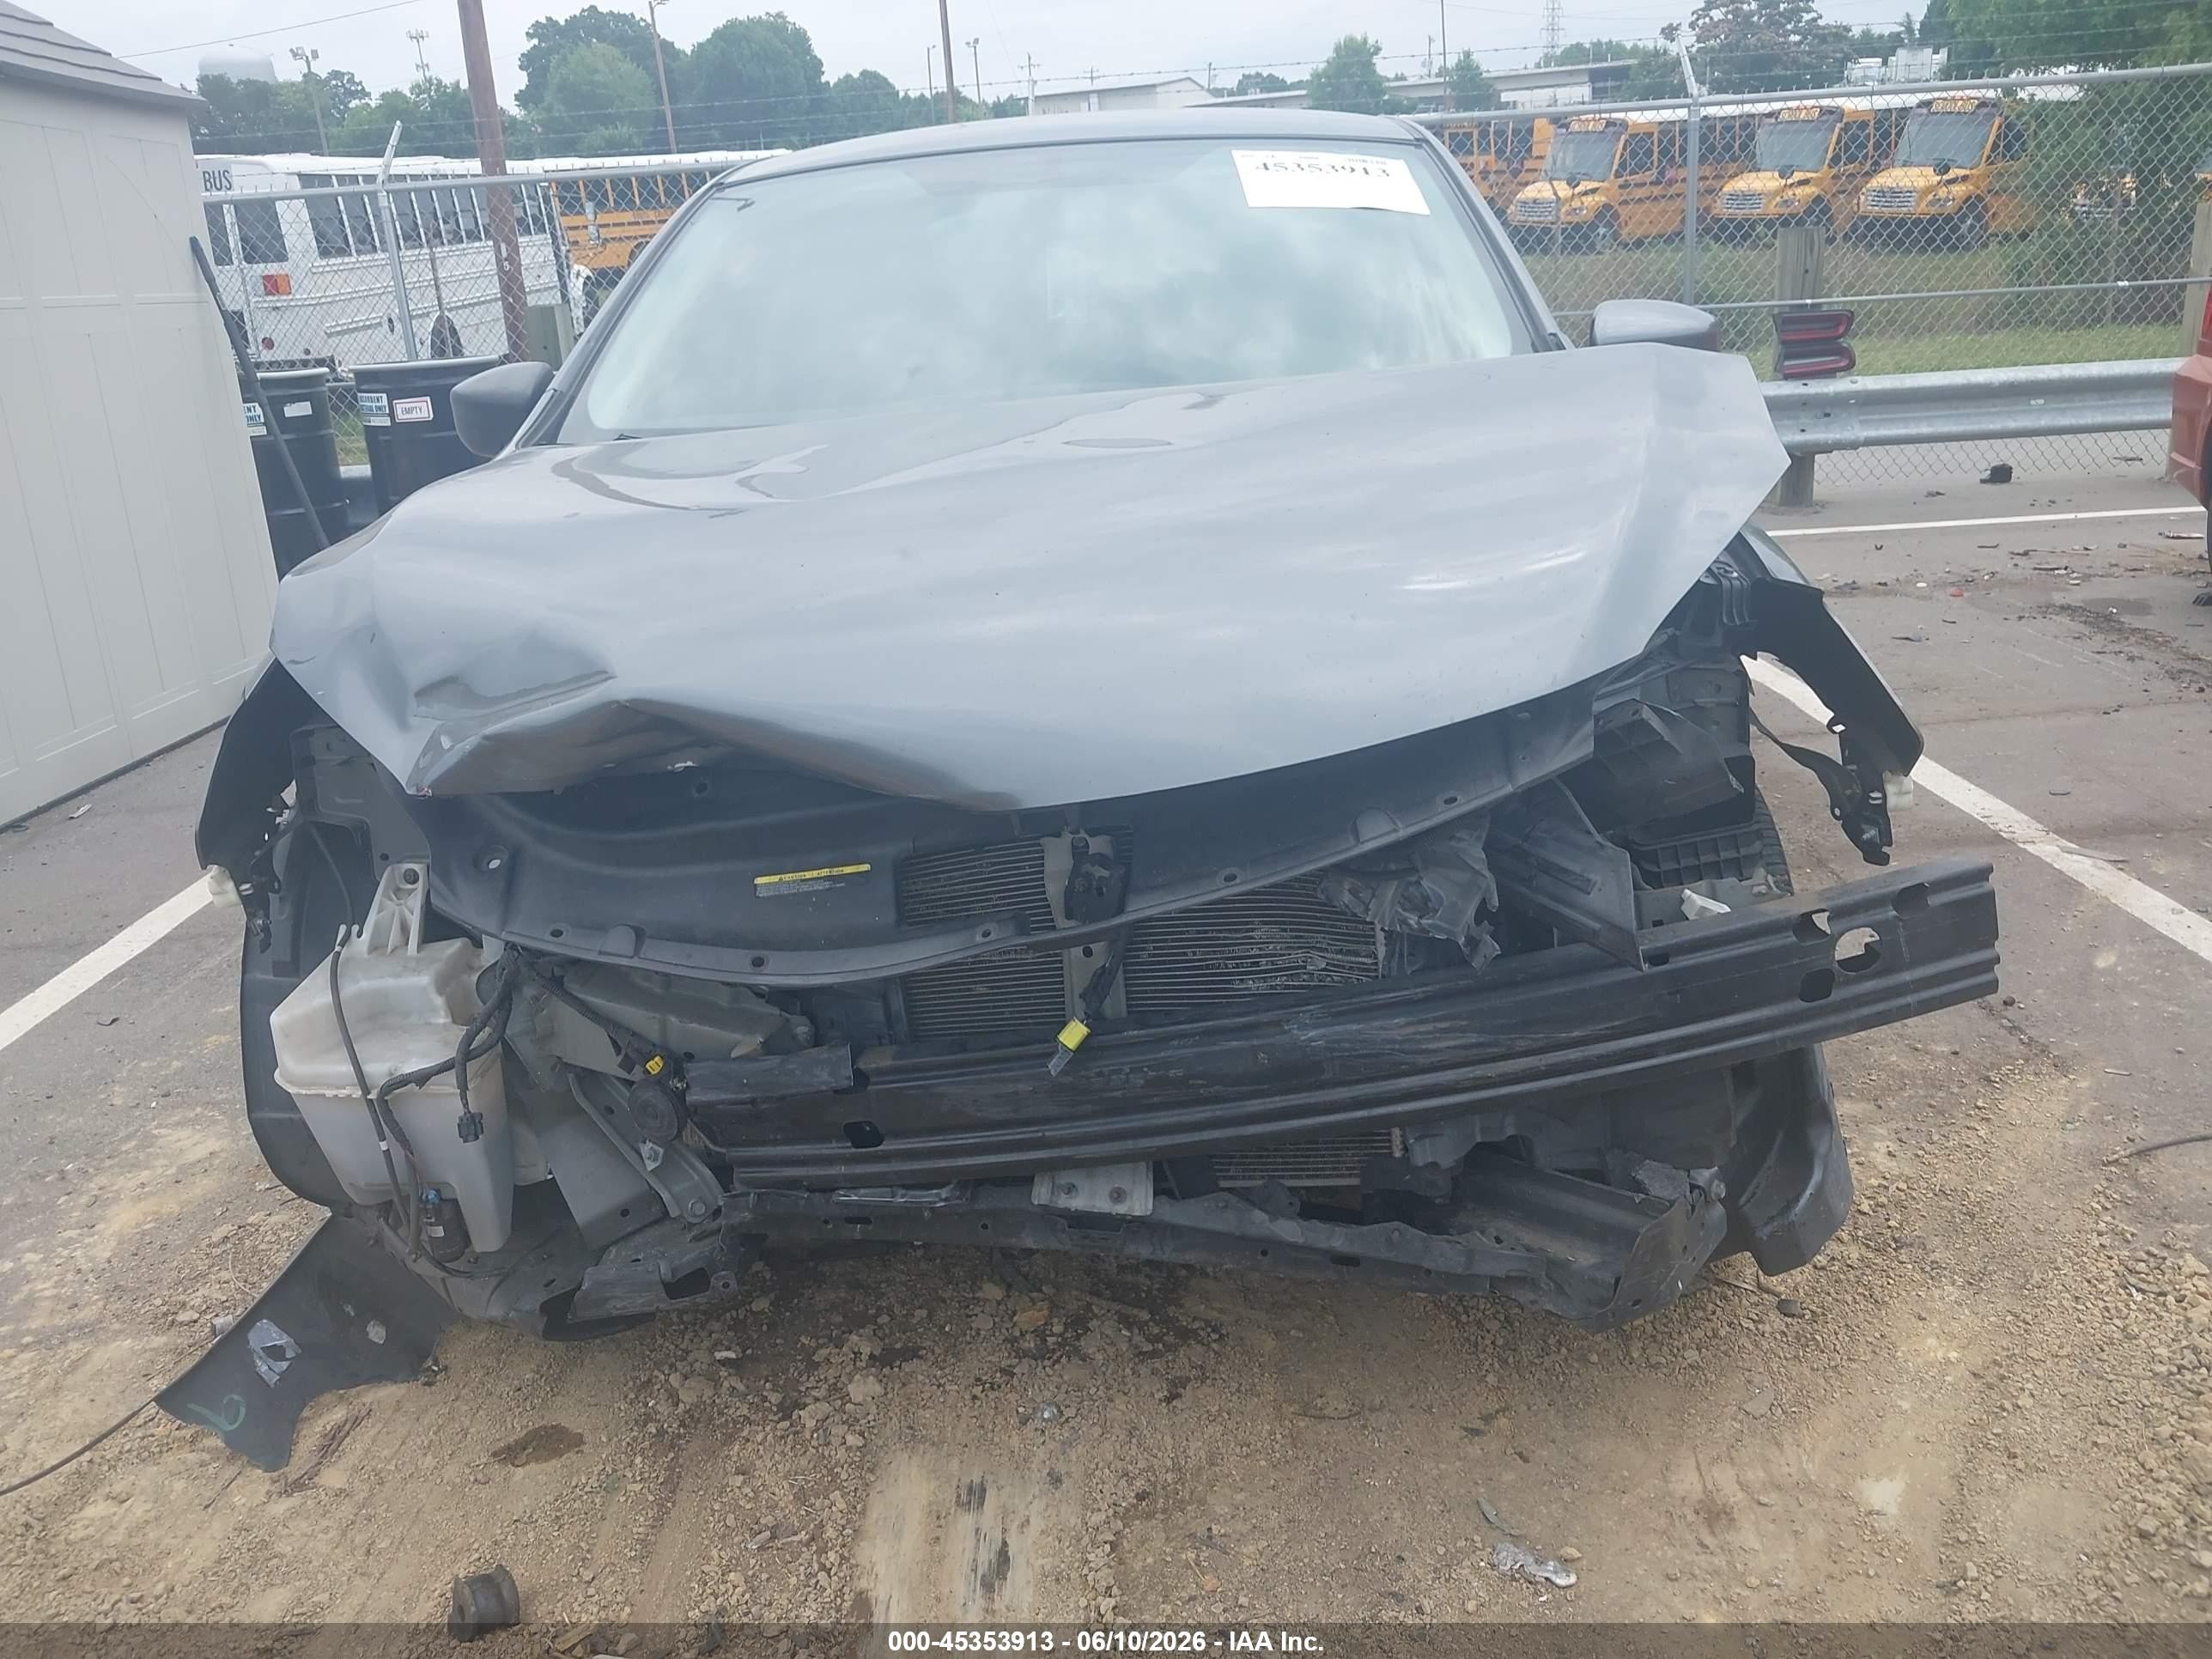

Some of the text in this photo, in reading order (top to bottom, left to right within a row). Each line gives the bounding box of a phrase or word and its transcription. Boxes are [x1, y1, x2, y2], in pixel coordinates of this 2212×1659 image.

[1255, 161, 1390, 178] 45353913
[202, 169, 233, 191] BUS
[400, 405, 423, 416] EMPTY
